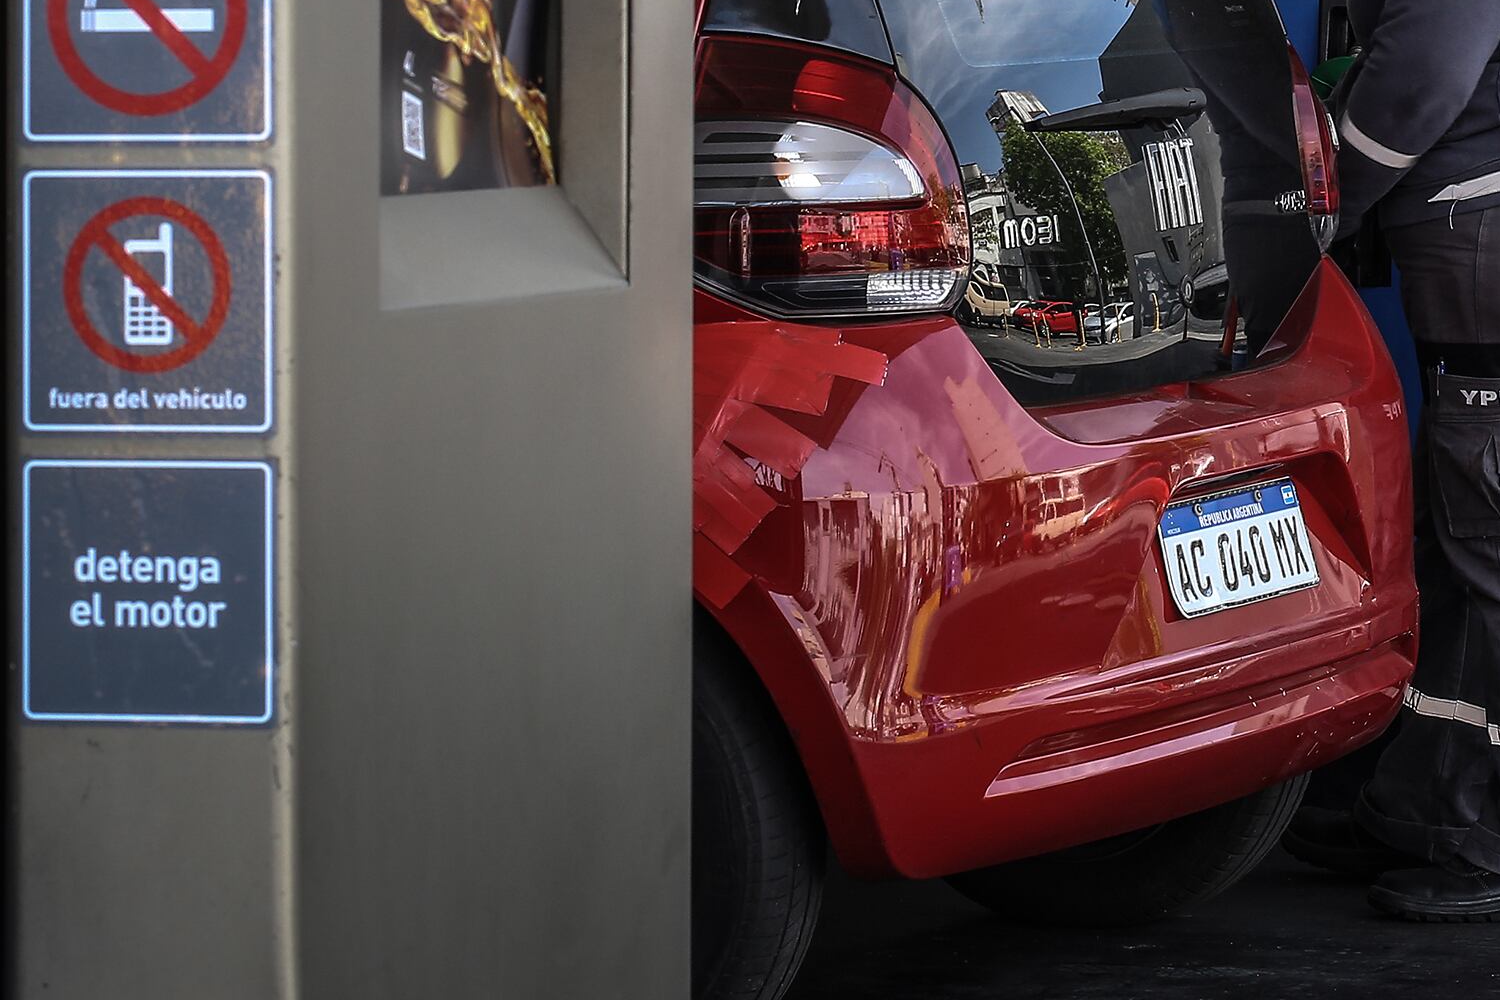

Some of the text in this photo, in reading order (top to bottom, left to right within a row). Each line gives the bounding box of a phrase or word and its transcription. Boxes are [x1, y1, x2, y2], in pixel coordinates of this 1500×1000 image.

[1141, 137, 1204, 232] FIAT
[49, 387, 108, 409] fuera
[113, 387, 149, 409] del
[1232, 502, 1264, 520] ARGENTINA
[74, 548, 221, 592] detenga
[1175, 515, 1310, 602] AC 040 MX
[69, 592, 227, 629] el motor
